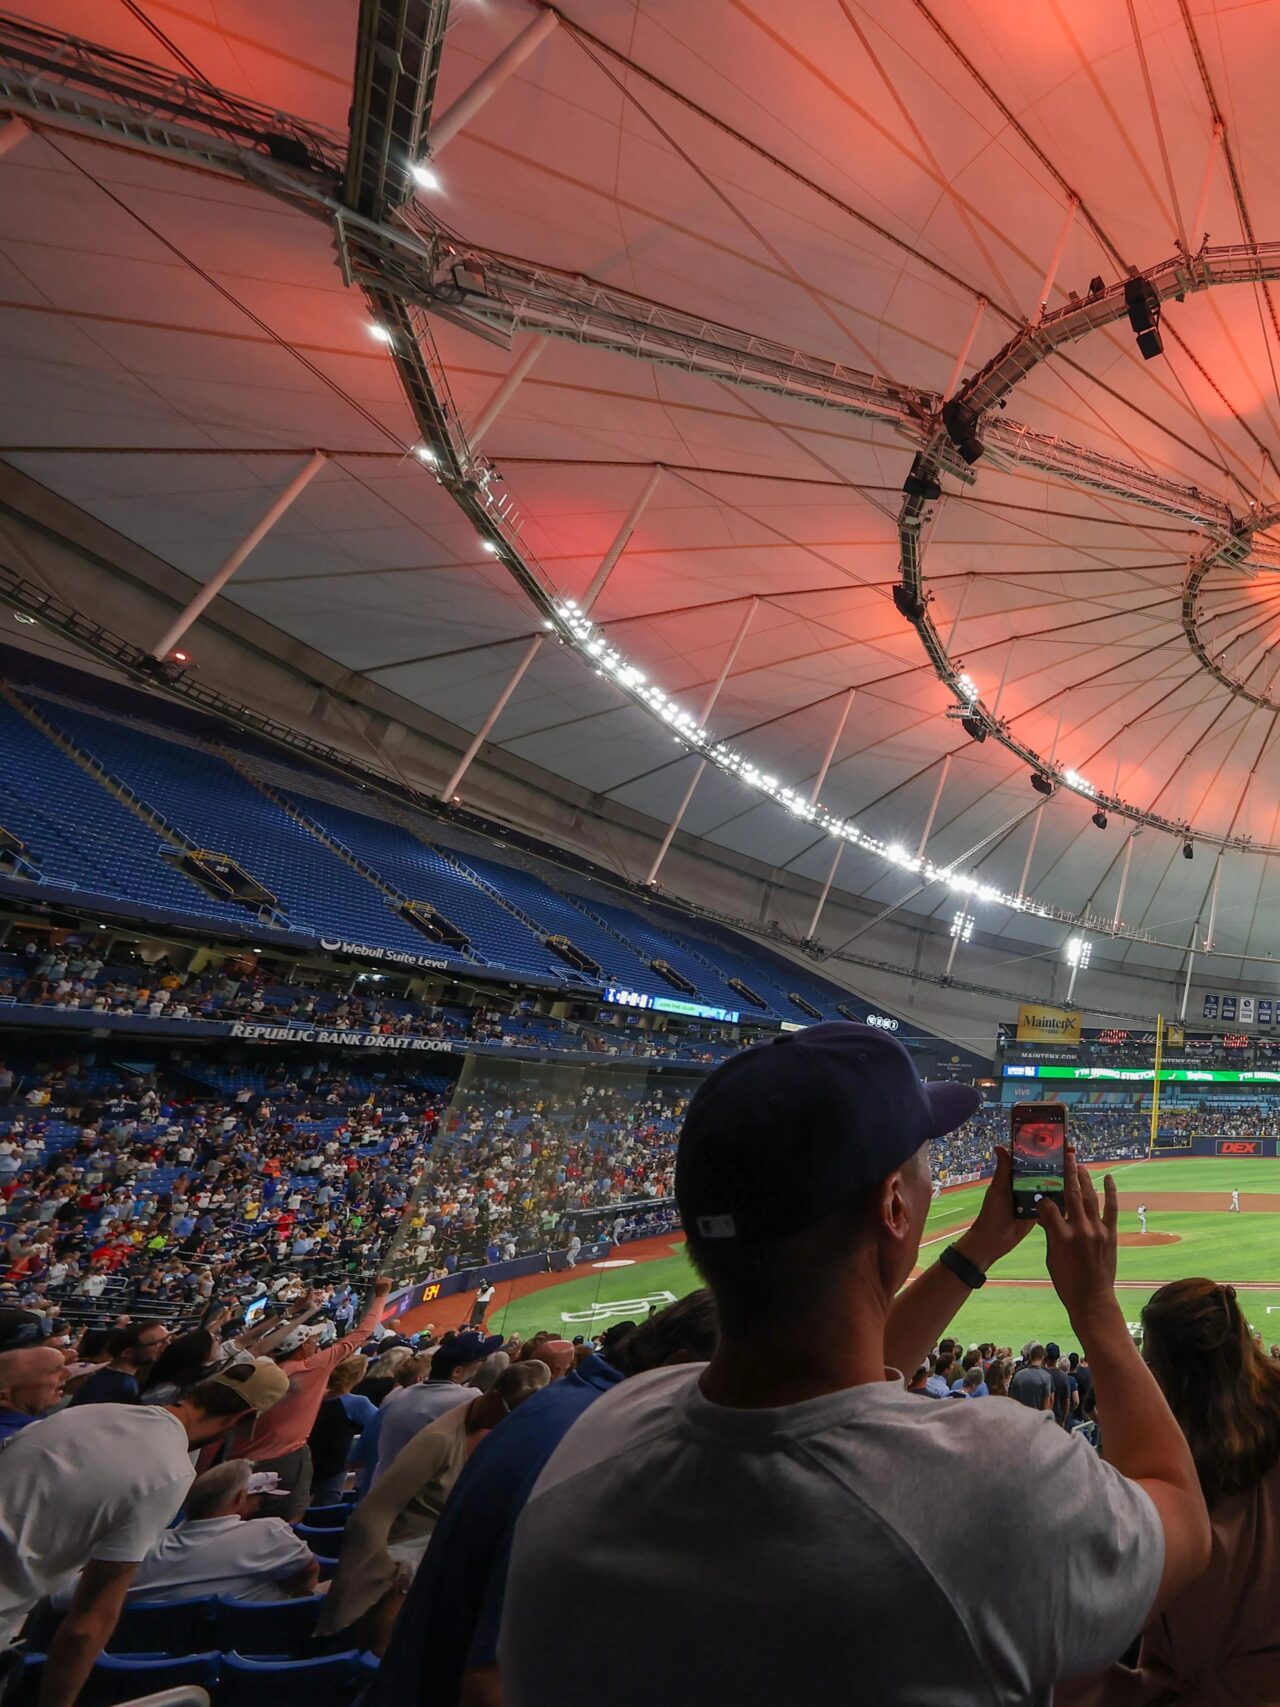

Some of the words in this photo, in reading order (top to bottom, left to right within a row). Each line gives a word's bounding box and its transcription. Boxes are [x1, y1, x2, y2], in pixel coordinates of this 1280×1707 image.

[342, 941, 383, 958] Webull
[384, 951, 415, 964] Suite
[418, 956, 448, 969] Level
[230, 1025, 314, 1042] REPUBLIC
[316, 1032, 360, 1045] BANK
[364, 1036, 412, 1048] DRAFT
[412, 1039, 452, 1051] ROOM
[1221, 1142, 1257, 1153] DEX
